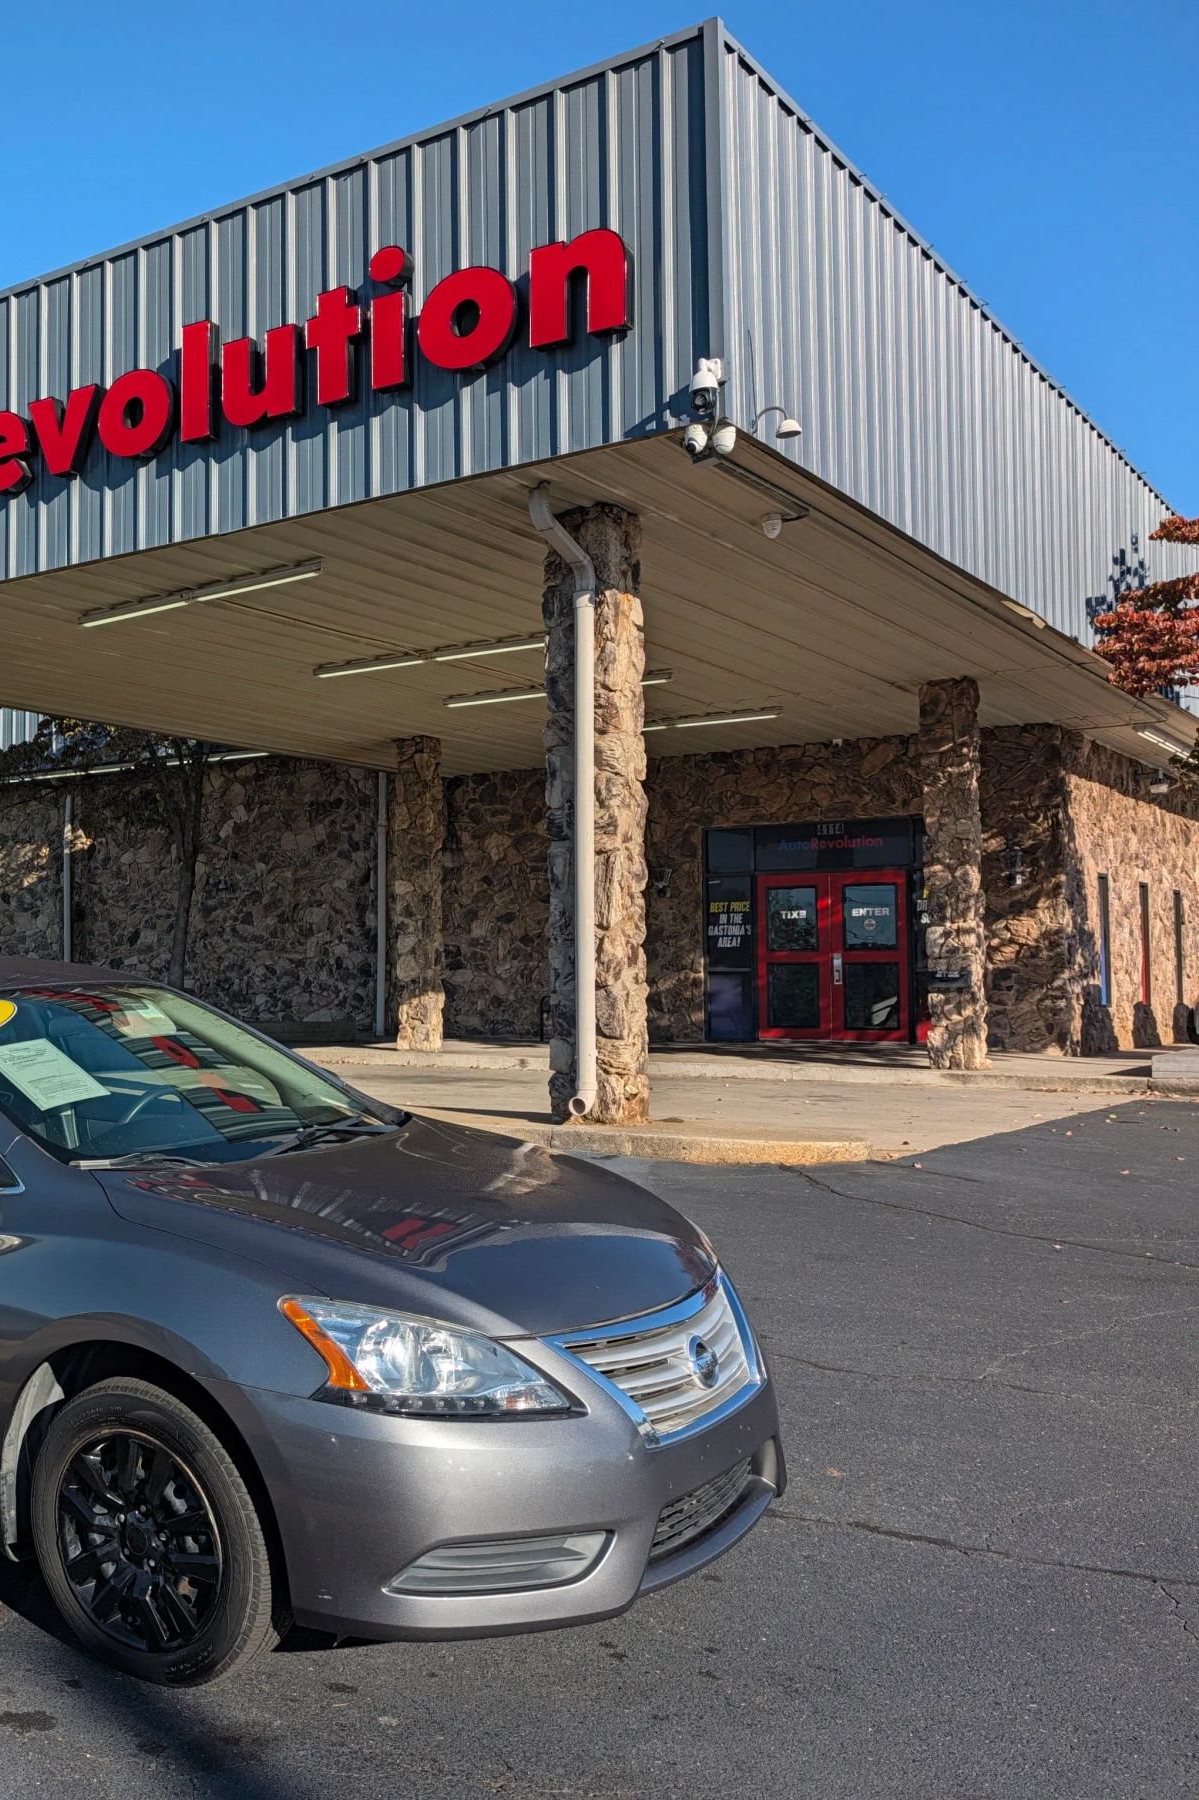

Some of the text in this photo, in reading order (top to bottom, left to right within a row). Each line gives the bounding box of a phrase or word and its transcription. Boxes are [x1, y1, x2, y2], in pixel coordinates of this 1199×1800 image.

[779, 835, 882, 850] AutoRevolution
[710, 901, 750, 912] BEST PRICE
[852, 907, 890, 917] ENTER
[719, 913, 743, 924] IN THE
[708, 924, 752, 936] GASTONIA'S
[717, 936, 741, 948] AREA!
